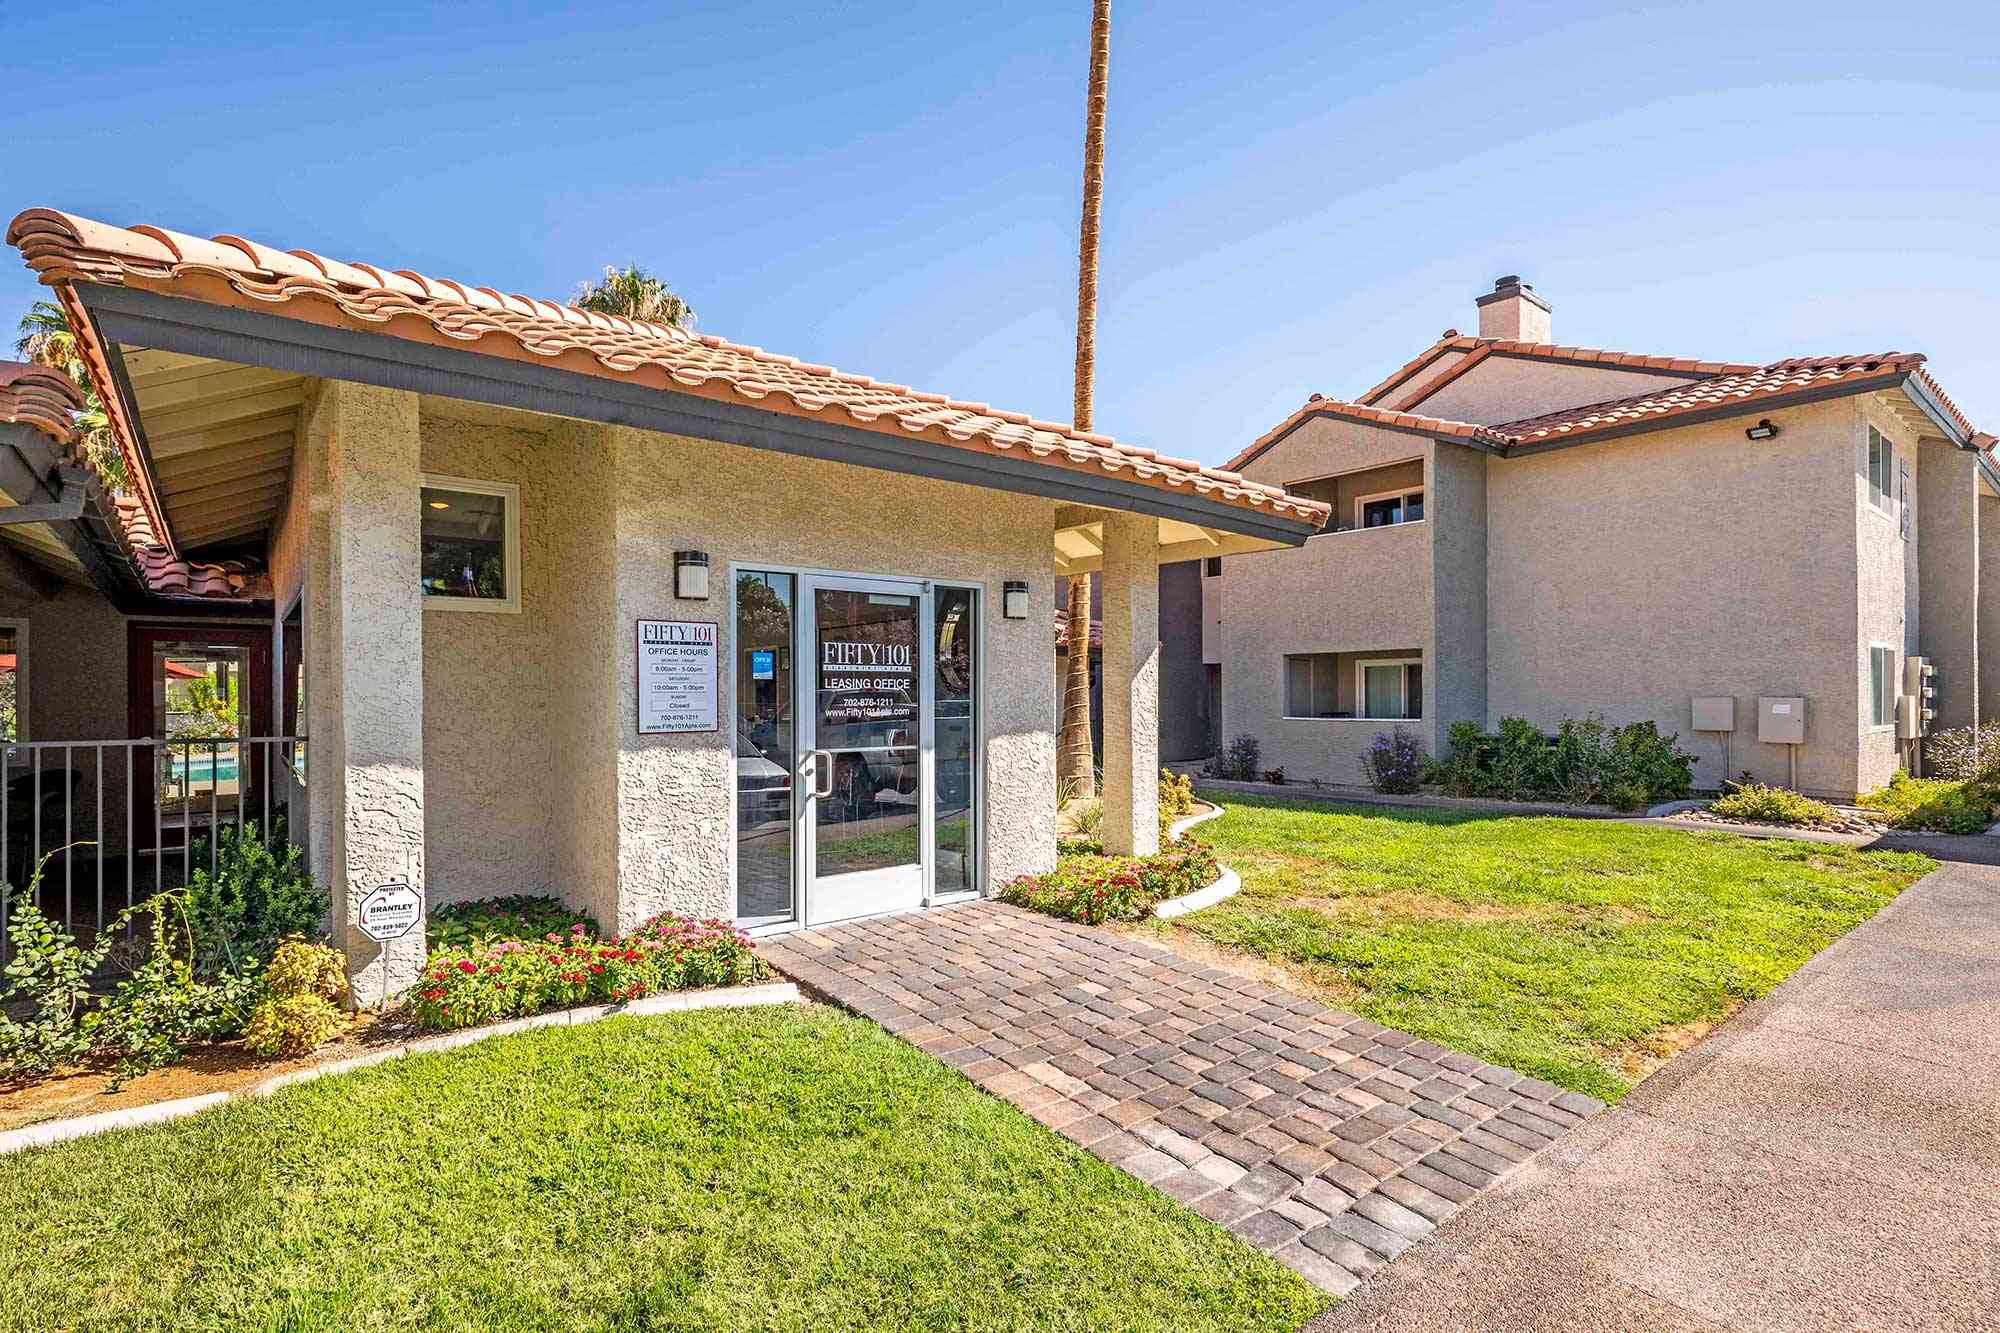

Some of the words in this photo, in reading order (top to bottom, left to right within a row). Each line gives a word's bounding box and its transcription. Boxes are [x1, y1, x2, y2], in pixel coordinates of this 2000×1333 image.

[644, 624, 688, 640] FIFTY
[694, 626, 711, 641] 101
[648, 647, 678, 656] OFFICE
[680, 648, 709, 657] HOURS
[823, 641, 881, 665] FIFTY
[886, 644, 912, 666] 101
[825, 678, 872, 689] LEASING
[873, 678, 911, 689] OFFICE
[843, 698, 894, 707] 702-876-1211
[370, 904, 413, 913] BRANTLEY
